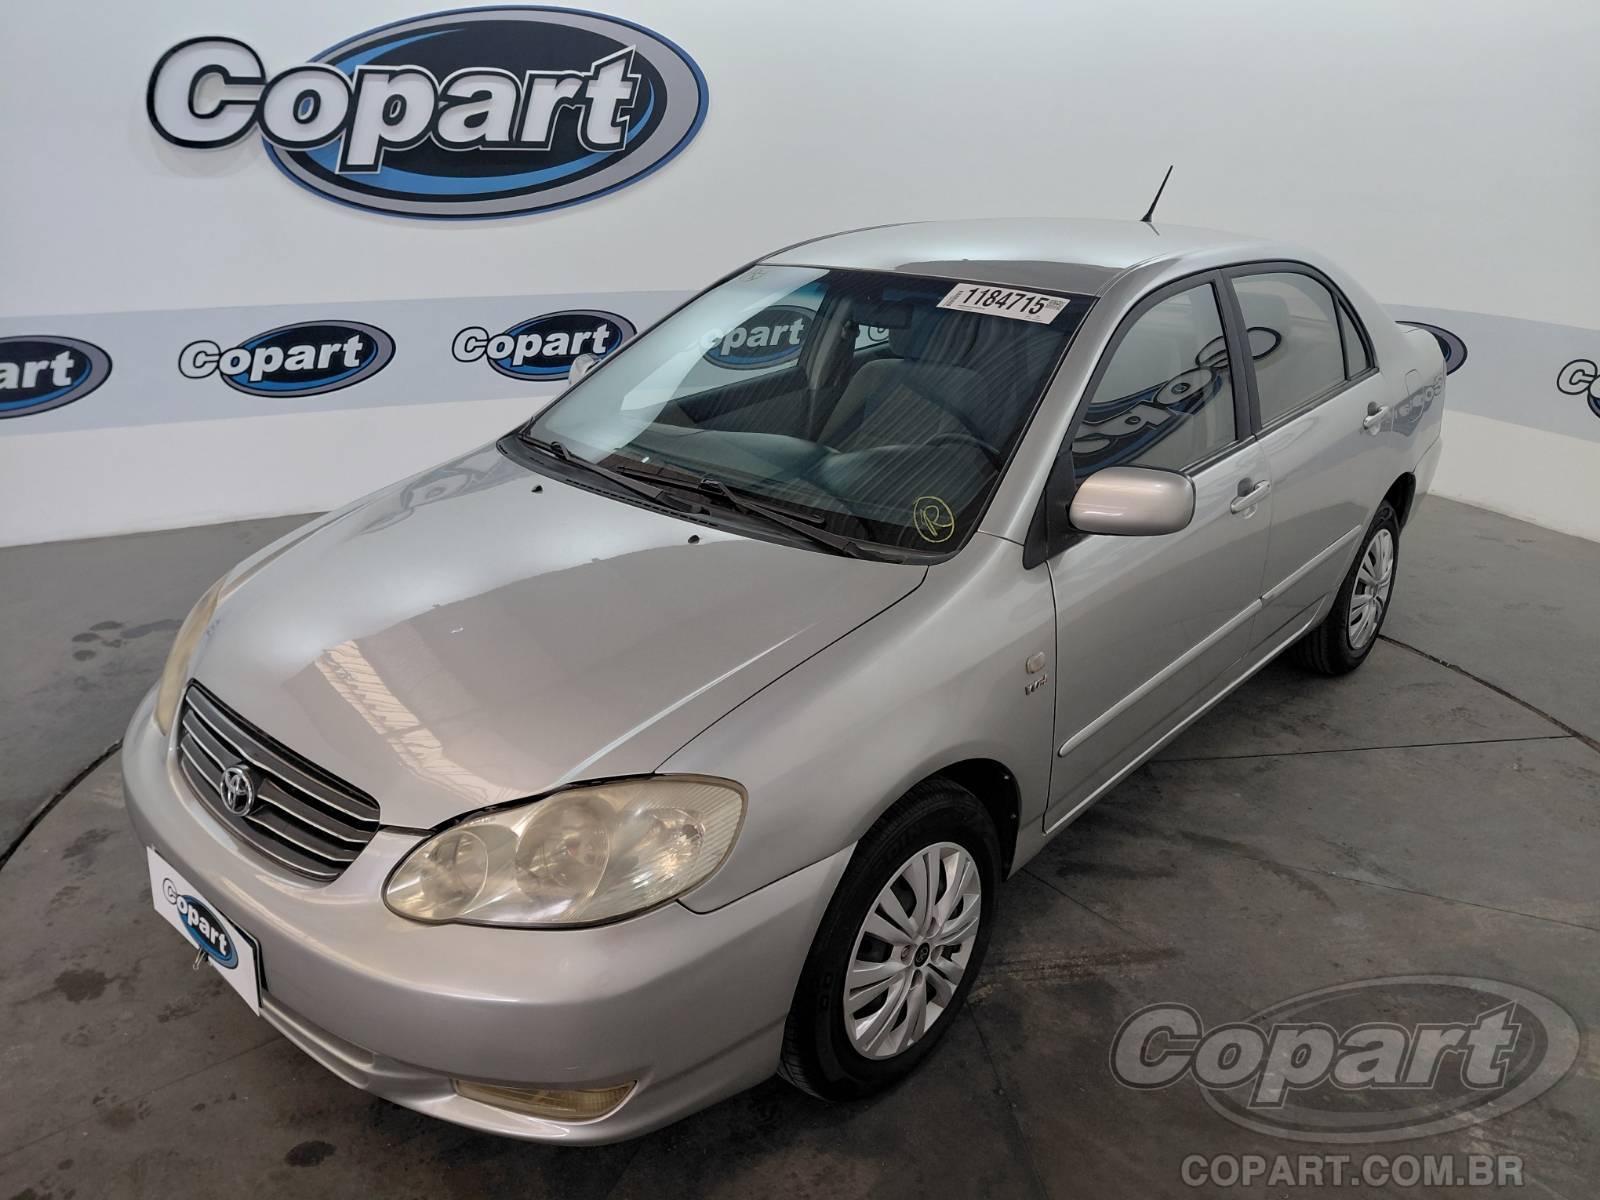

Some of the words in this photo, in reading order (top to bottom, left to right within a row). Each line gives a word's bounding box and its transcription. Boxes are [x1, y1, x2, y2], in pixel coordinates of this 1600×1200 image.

[147, 37, 643, 174] Copart
[963, 288, 1049, 315] 1184715
[179, 334, 364, 382] Copart
[452, 322, 610, 367] Copart
[163, 878, 227, 956] Copart
